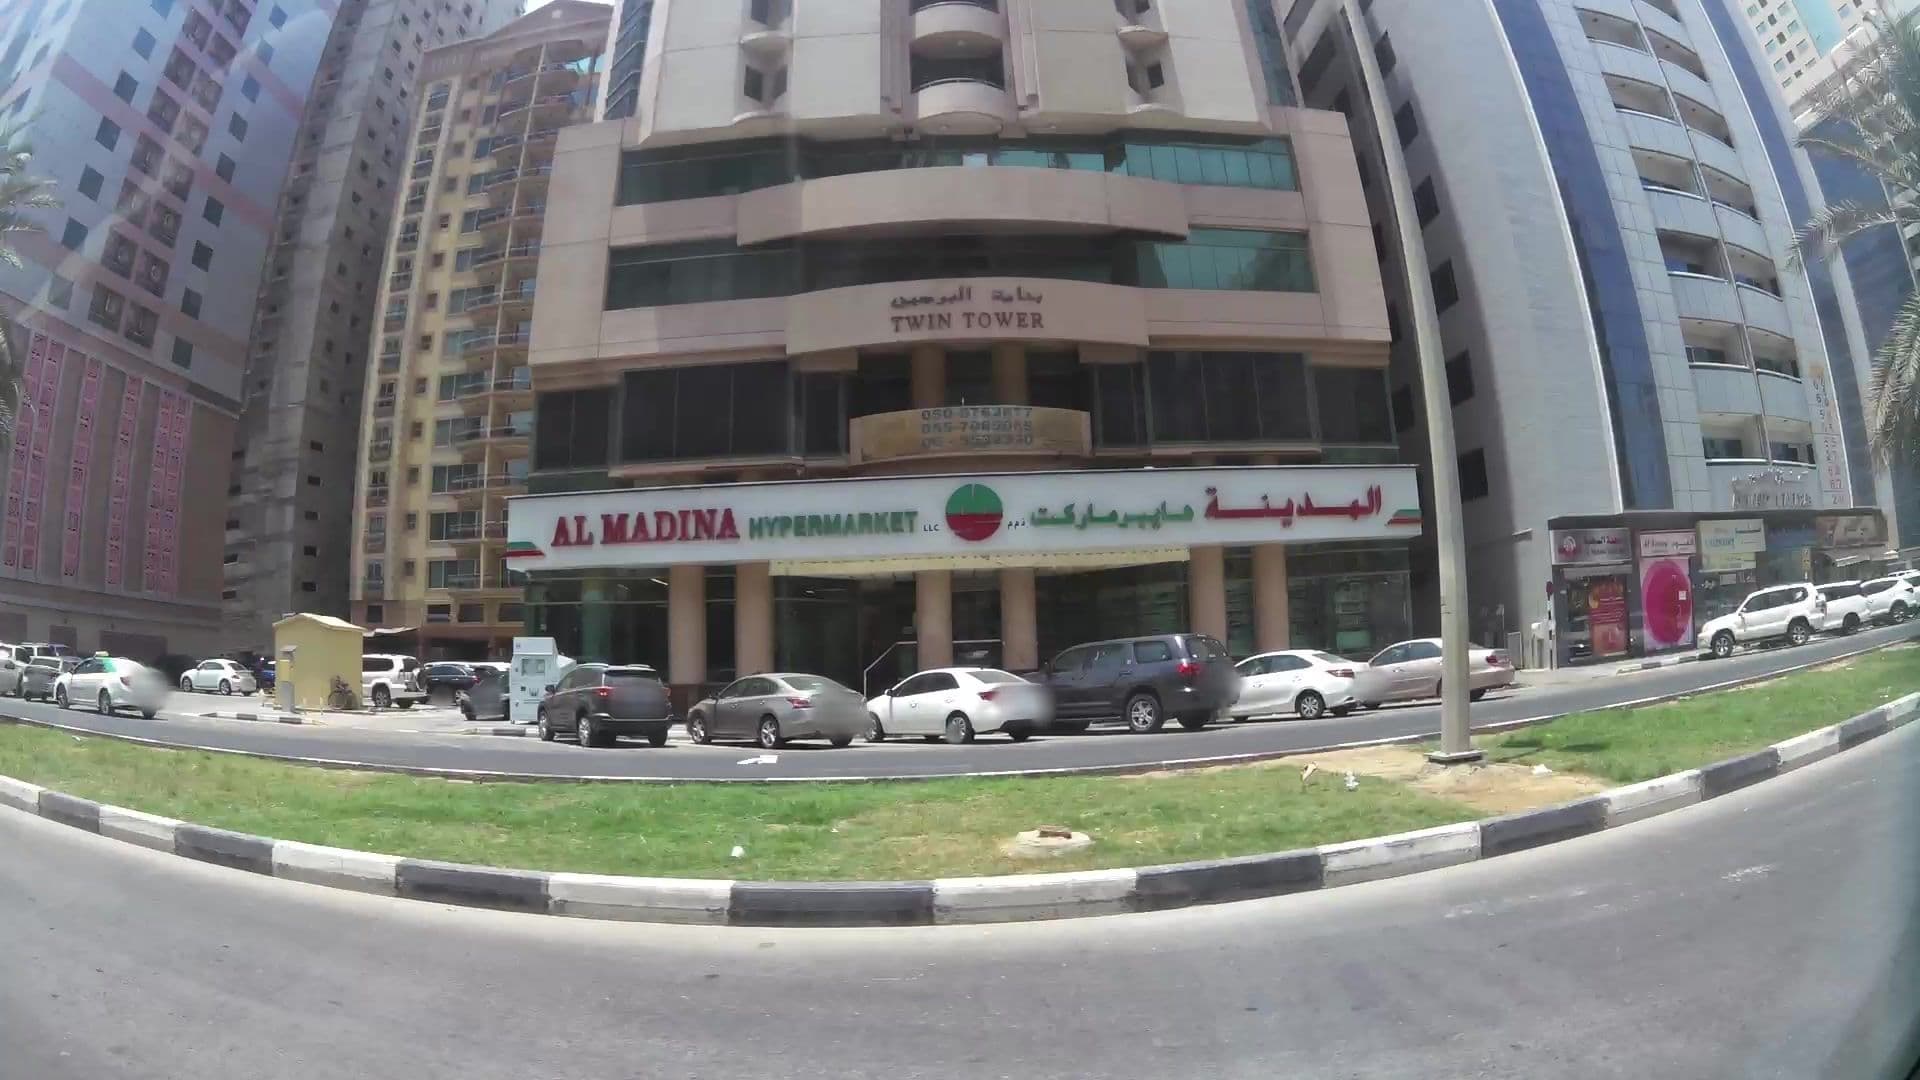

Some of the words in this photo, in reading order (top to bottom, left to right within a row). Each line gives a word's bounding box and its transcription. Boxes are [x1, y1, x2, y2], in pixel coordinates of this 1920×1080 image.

[890, 312, 952, 333] TWIN
[962, 311, 1045, 329] TOWER
[1204, 484, 1382, 528] المدينة
[551, 515, 594, 547] AL
[601, 508, 740, 545] MADINA
[749, 510, 919, 539] HYPERMARKET
[923, 523, 940, 532] LLC
